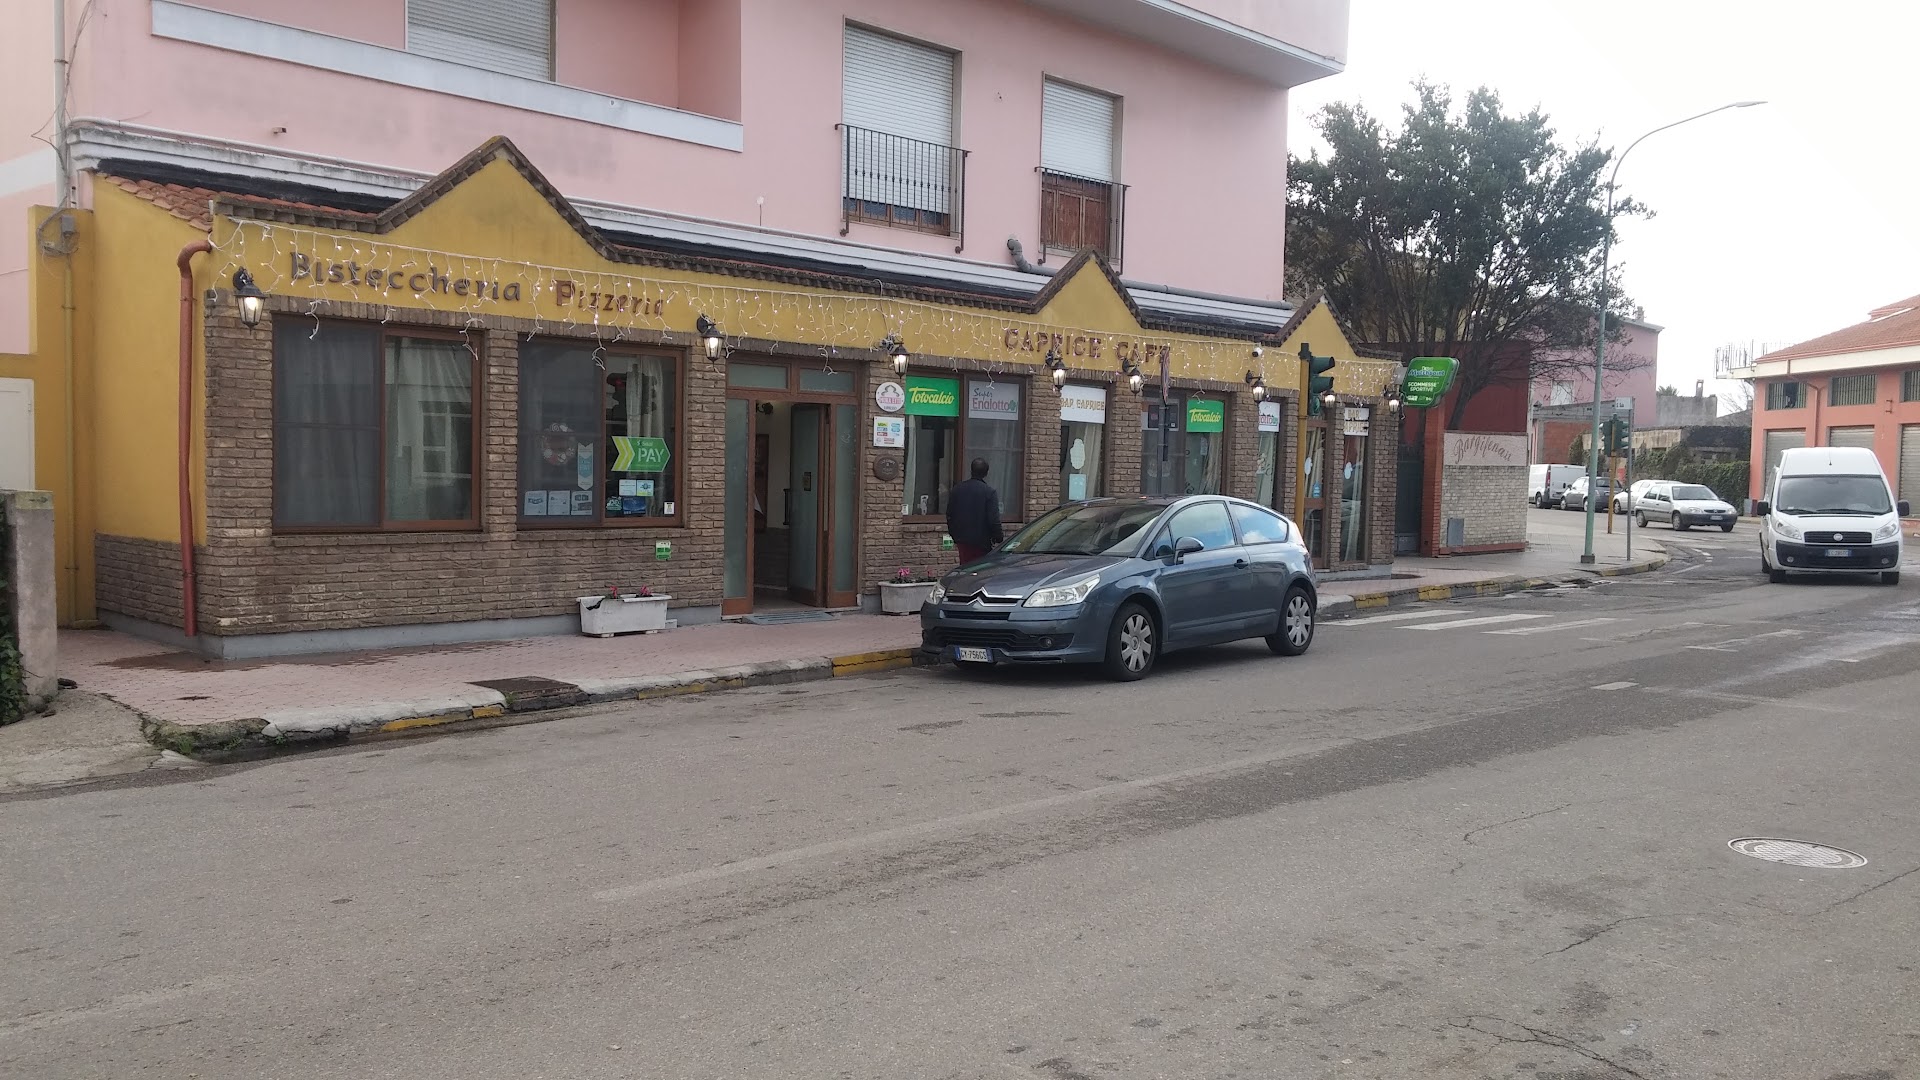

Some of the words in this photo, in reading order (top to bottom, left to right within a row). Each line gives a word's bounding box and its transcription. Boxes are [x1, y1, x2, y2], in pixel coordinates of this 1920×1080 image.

[290, 252, 521, 301] Bisteccheria
[555, 279, 664, 316] Pizzeria
[1004, 329, 1101, 358] CAPRICE
[908, 386, 955, 405] Totocalcio
[973, 387, 993, 402] Super
[972, 397, 1010, 412] Enalotto
[1189, 408, 1222, 423] Totocalcio
[638, 448, 664, 462] PAY
